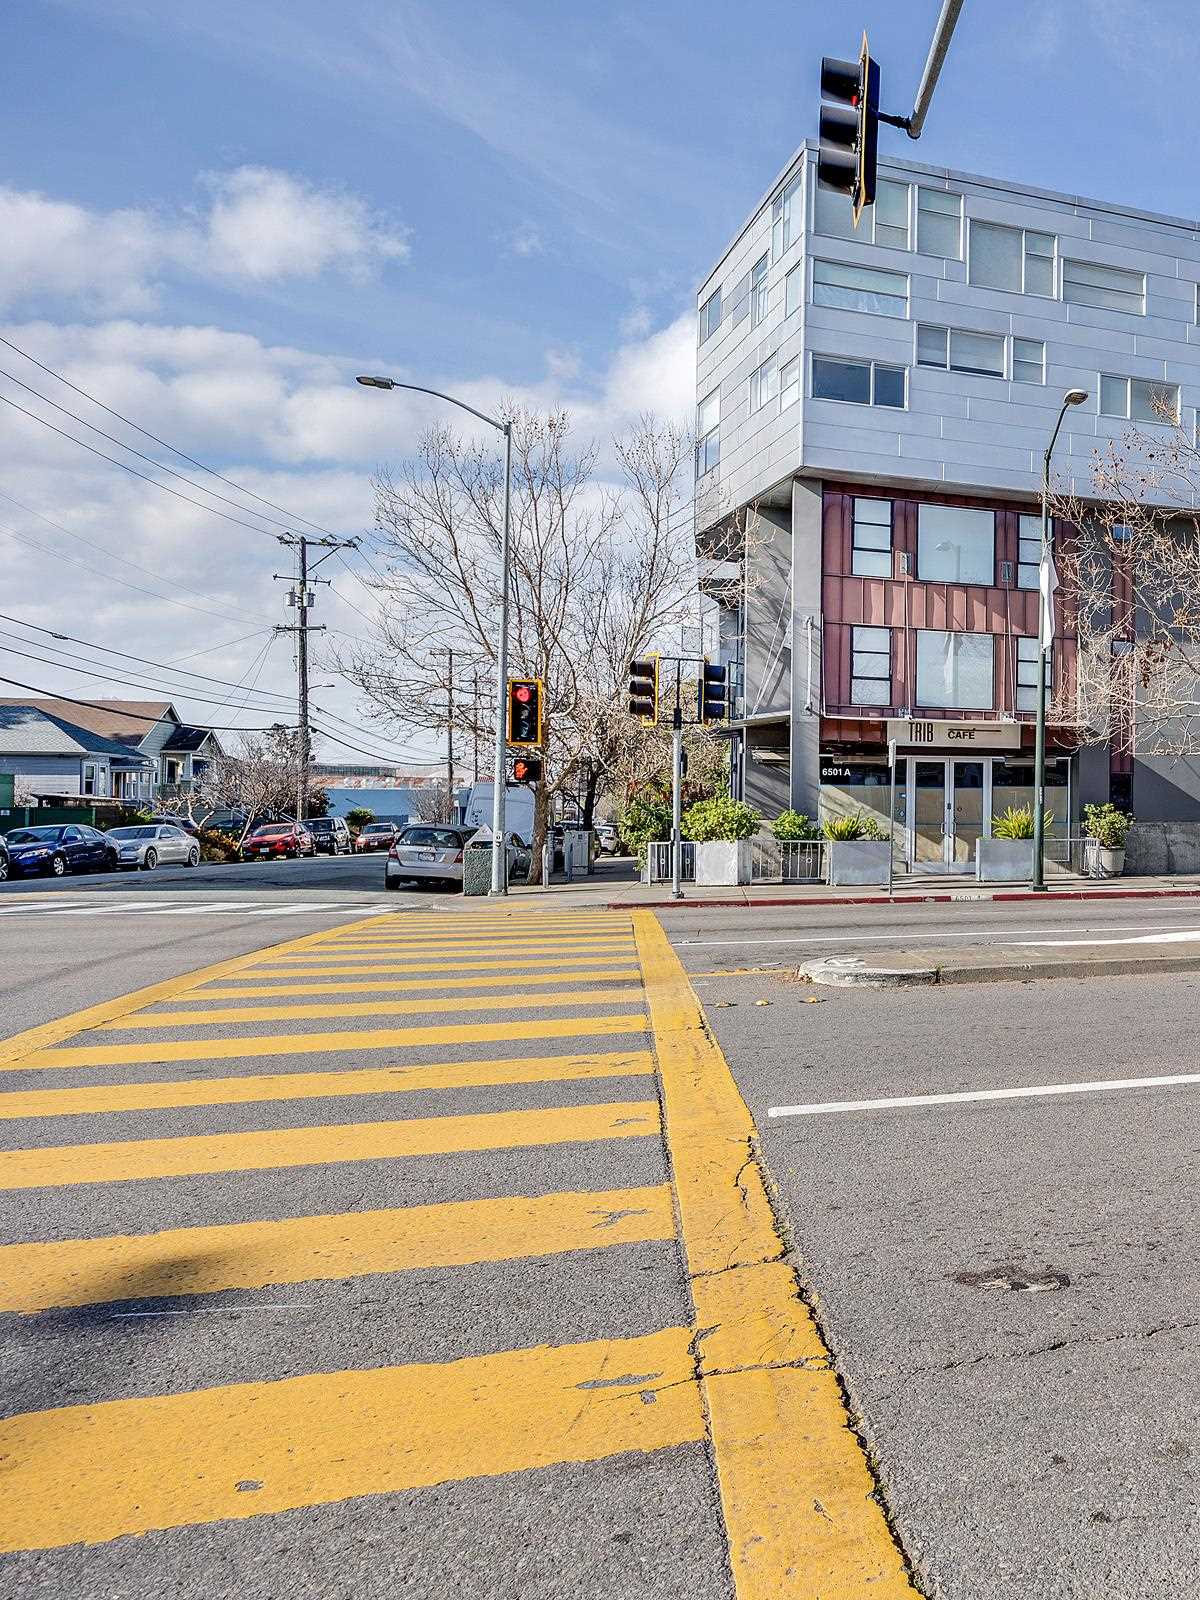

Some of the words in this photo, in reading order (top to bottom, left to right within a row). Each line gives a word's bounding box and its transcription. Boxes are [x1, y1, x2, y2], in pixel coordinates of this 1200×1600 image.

[908, 722, 934, 742] TRIB
[822, 768, 842, 776] 6501
[844, 768, 851, 776] A
